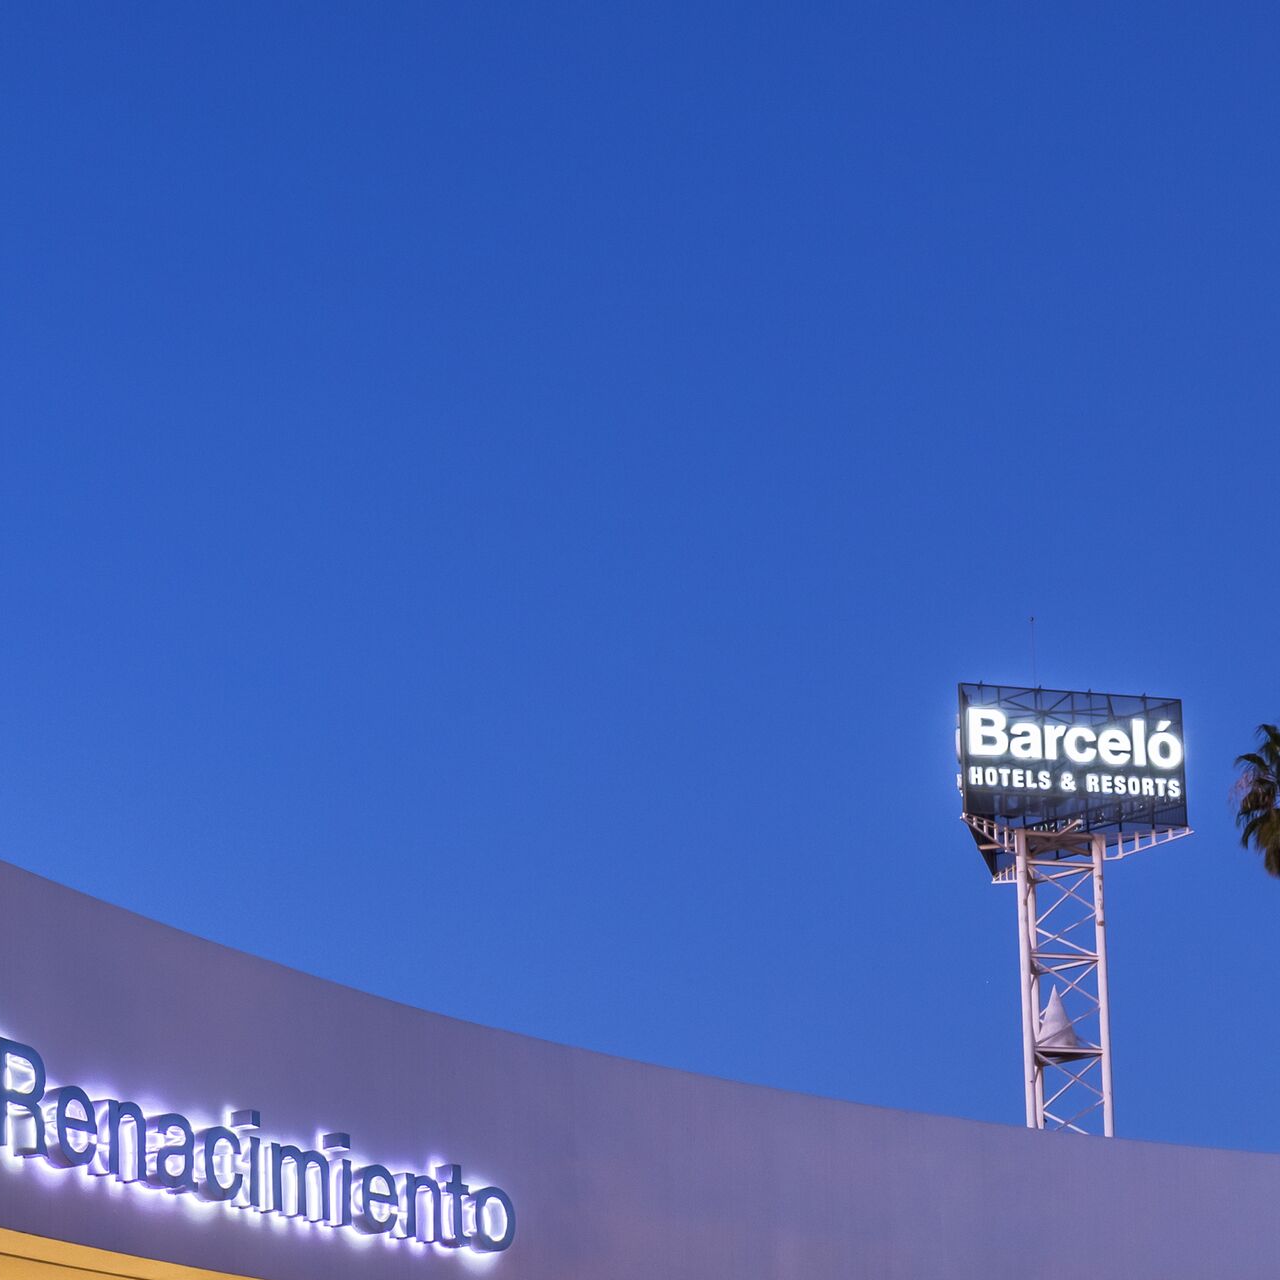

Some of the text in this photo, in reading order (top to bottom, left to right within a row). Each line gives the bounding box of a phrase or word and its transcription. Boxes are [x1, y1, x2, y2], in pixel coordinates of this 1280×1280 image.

[968, 707, 1183, 769] Barceló
[969, 766, 1182, 798] HOTELS & RESORTS
